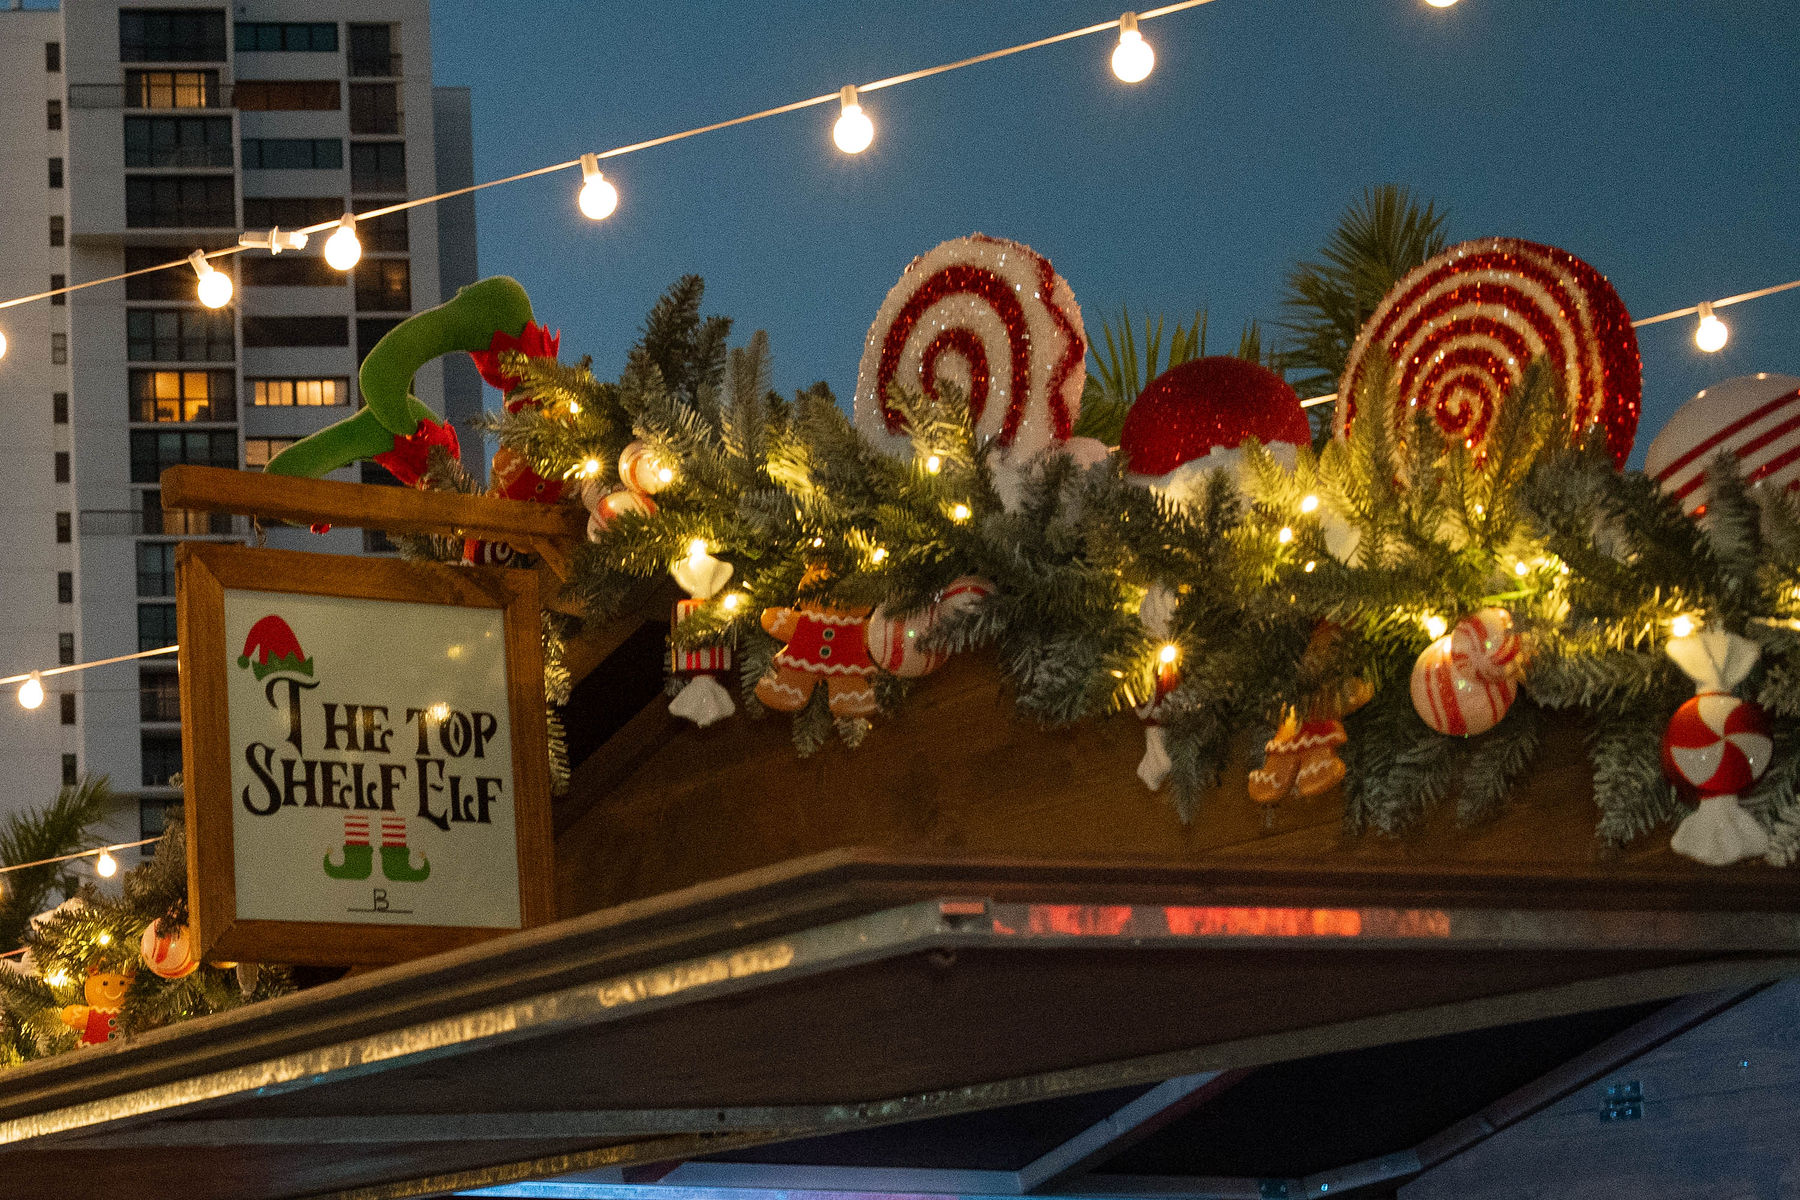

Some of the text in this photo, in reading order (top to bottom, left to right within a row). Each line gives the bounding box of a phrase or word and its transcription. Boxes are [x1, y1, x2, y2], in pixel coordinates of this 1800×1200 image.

[265, 675, 499, 759] THE TOP
[242, 742, 503, 832] SHELF ELF
